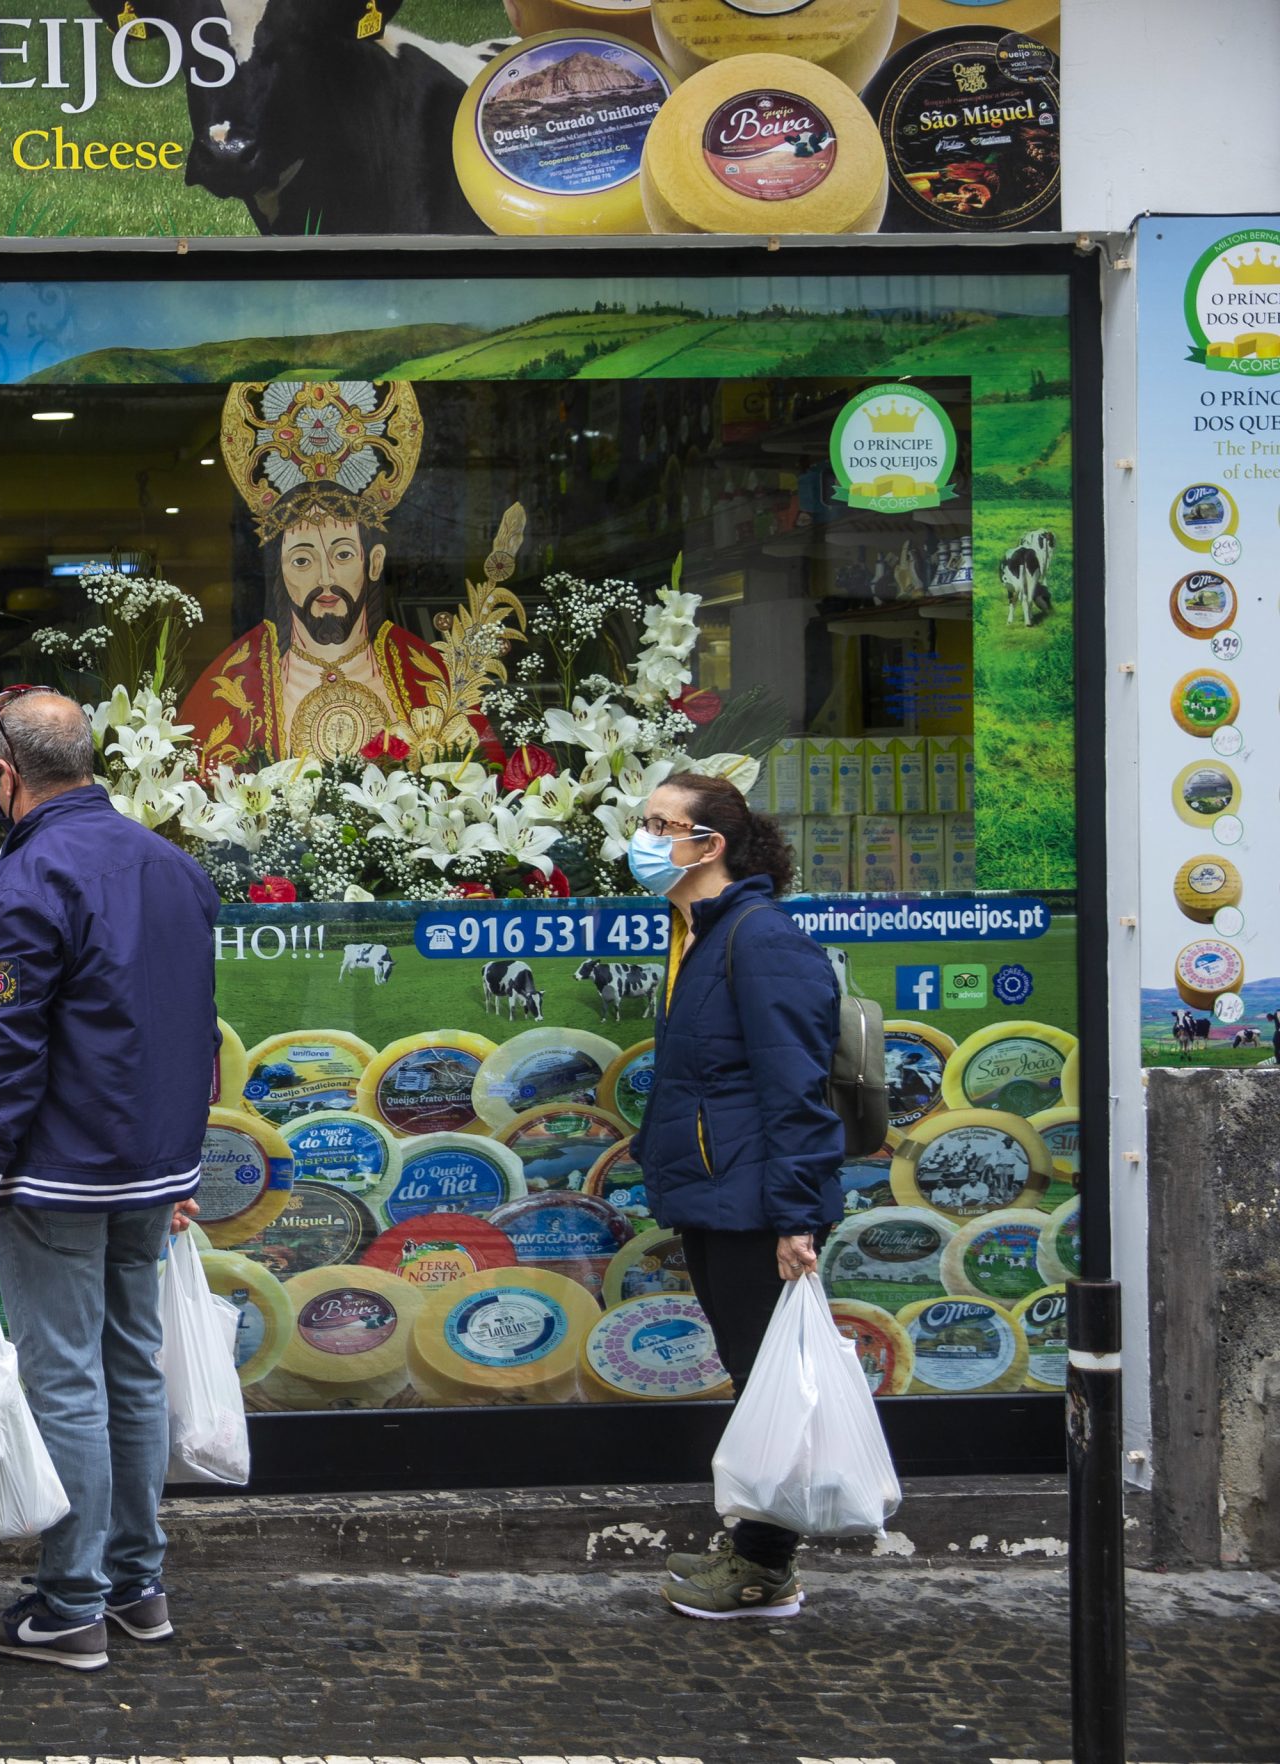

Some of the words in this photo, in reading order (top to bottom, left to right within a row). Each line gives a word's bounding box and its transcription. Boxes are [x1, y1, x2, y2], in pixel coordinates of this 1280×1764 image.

[919, 109, 958, 132] São
[962, 98, 1036, 129] Miguel
[493, 125, 538, 145] Queijo
[545, 115, 595, 133] Curado
[597, 101, 661, 123] Uniflores
[720, 108, 815, 144] Beira
[12, 126, 184, 171] Cheese
[538, 153, 580, 167] Cooperativa
[1214, 230, 1248, 254] MILTON
[1211, 293, 1224, 305] O
[1207, 313, 1238, 325] DOS
[1200, 390, 1216, 407] O
[1194, 416, 1234, 432] DOS
[853, 439, 865, 450] O
[868, 437, 933, 451] PRÍNCIPE
[1214, 440, 1246, 456] The
[849, 457, 877, 469] DOS
[881, 456, 938, 471] QUEIJOS
[1223, 464, 1241, 479] of
[869, 496, 919, 510] AÇORES
[792, 903, 1044, 938] oprincipedosqueijos.pt
[460, 916, 523, 953] 916
[534, 915, 595, 952] 531
[606, 915, 668, 951] 433
[946, 991, 984, 999] tripadvisor
[292, 1050, 330, 1058] uniflores
[976, 1059, 1010, 1080] São
[1014, 1053, 1056, 1078] João
[270, 1089, 300, 1100] Queijo
[301, 1080, 351, 1094] Tradicional
[386, 1096, 416, 1105] Queijo
[420, 1095, 443, 1103] Prato
[445, 1093, 472, 1102] Uniflo
[310, 1128, 318, 1137] O
[320, 1127, 350, 1137] Queijo
[299, 1137, 320, 1149] do
[326, 1134, 352, 1147] Rei
[413, 1167, 425, 1179] O
[428, 1164, 473, 1178] Queijo
[399, 1181, 430, 1200] do
[438, 1174, 478, 1195] Rei
[281, 1215, 332, 1229] Miguel
[508, 1233, 599, 1244] NAVEGADOR
[866, 1228, 935, 1250] Milhafre
[416, 1261, 460, 1270] TERRA
[311, 1299, 381, 1322] Beira
[488, 1322, 527, 1338] LOURAIS
